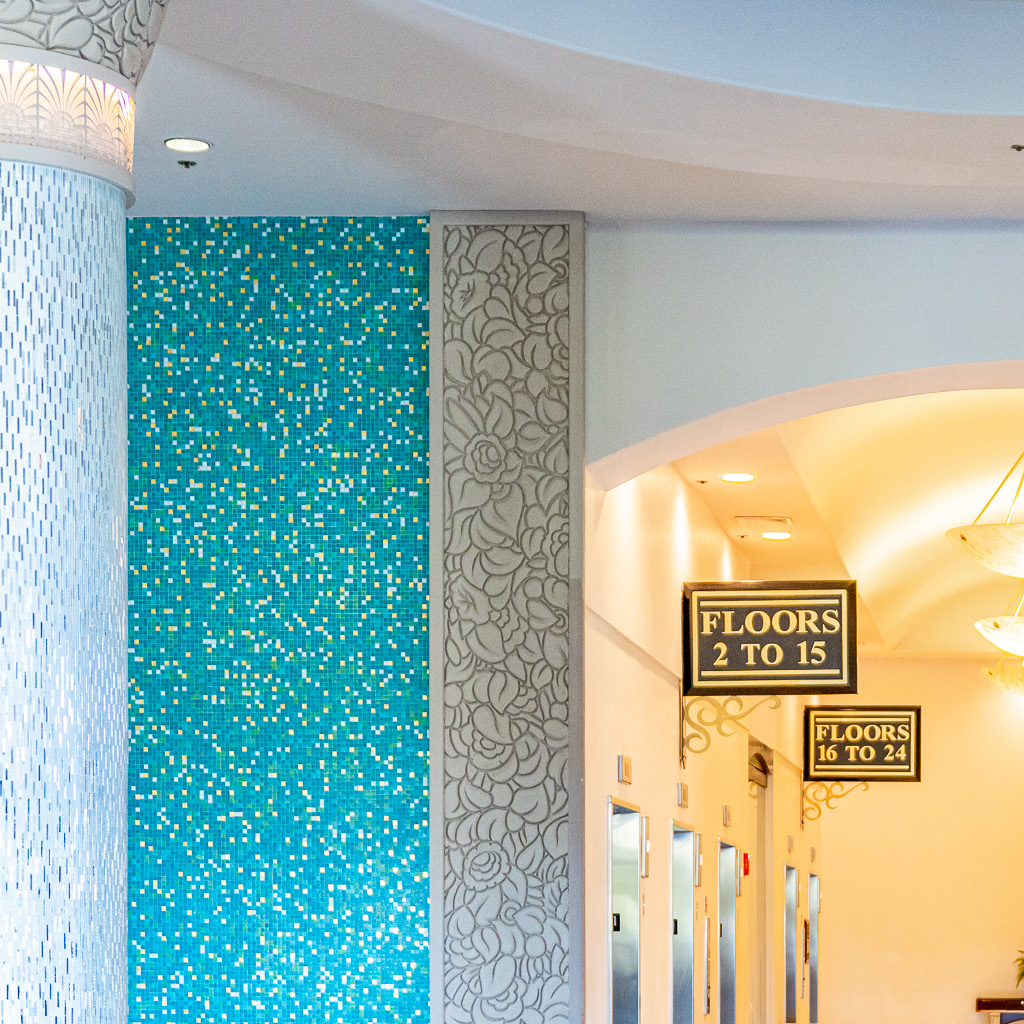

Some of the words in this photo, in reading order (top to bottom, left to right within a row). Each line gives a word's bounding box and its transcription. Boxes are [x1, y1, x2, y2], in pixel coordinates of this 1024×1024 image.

[700, 609, 841, 635] FLOORS
[713, 642, 729, 666] 2
[740, 643, 784, 665] TO
[797, 640, 827, 664] 15
[815, 724, 910, 741] FLOORS
[817, 744, 837, 761] 16
[845, 745, 876, 761] TO
[883, 744, 907, 761] 24
